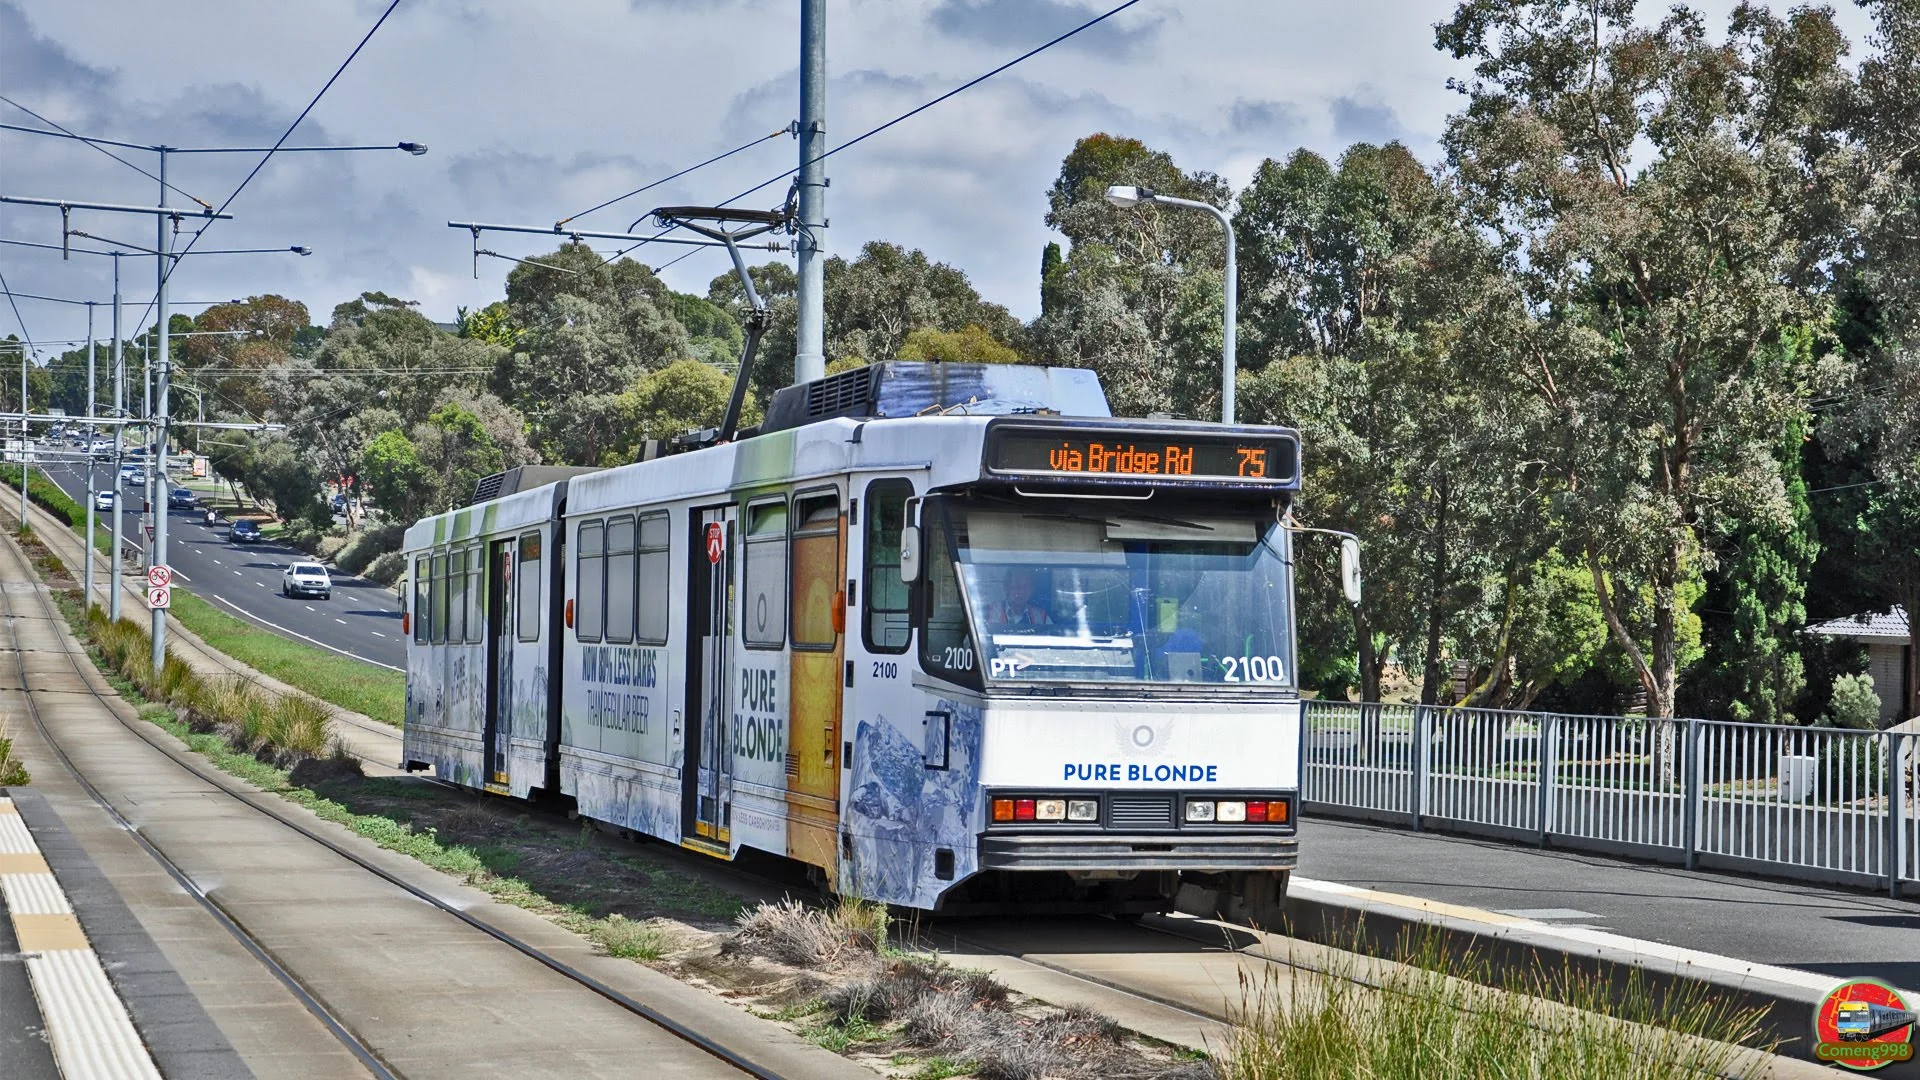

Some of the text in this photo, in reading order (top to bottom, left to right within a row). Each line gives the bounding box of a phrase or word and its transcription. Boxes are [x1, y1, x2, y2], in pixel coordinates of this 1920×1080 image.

[1050, 443, 1266, 477] via Bridge Rd 75
[709, 528, 721, 539] STOP
[582, 646, 598, 682] NOW
[613, 648, 631, 686] LESS
[632, 649, 657, 688] CARBS
[872, 661, 897, 679] 2100
[944, 646, 973, 671] 2100
[1222, 655, 1284, 682] 2100
[741, 668, 776, 712] PURE
[631, 694, 649, 735] BEER
[733, 713, 783, 762] BLONDE
[1064, 763, 1218, 782] PURE BLONDE
